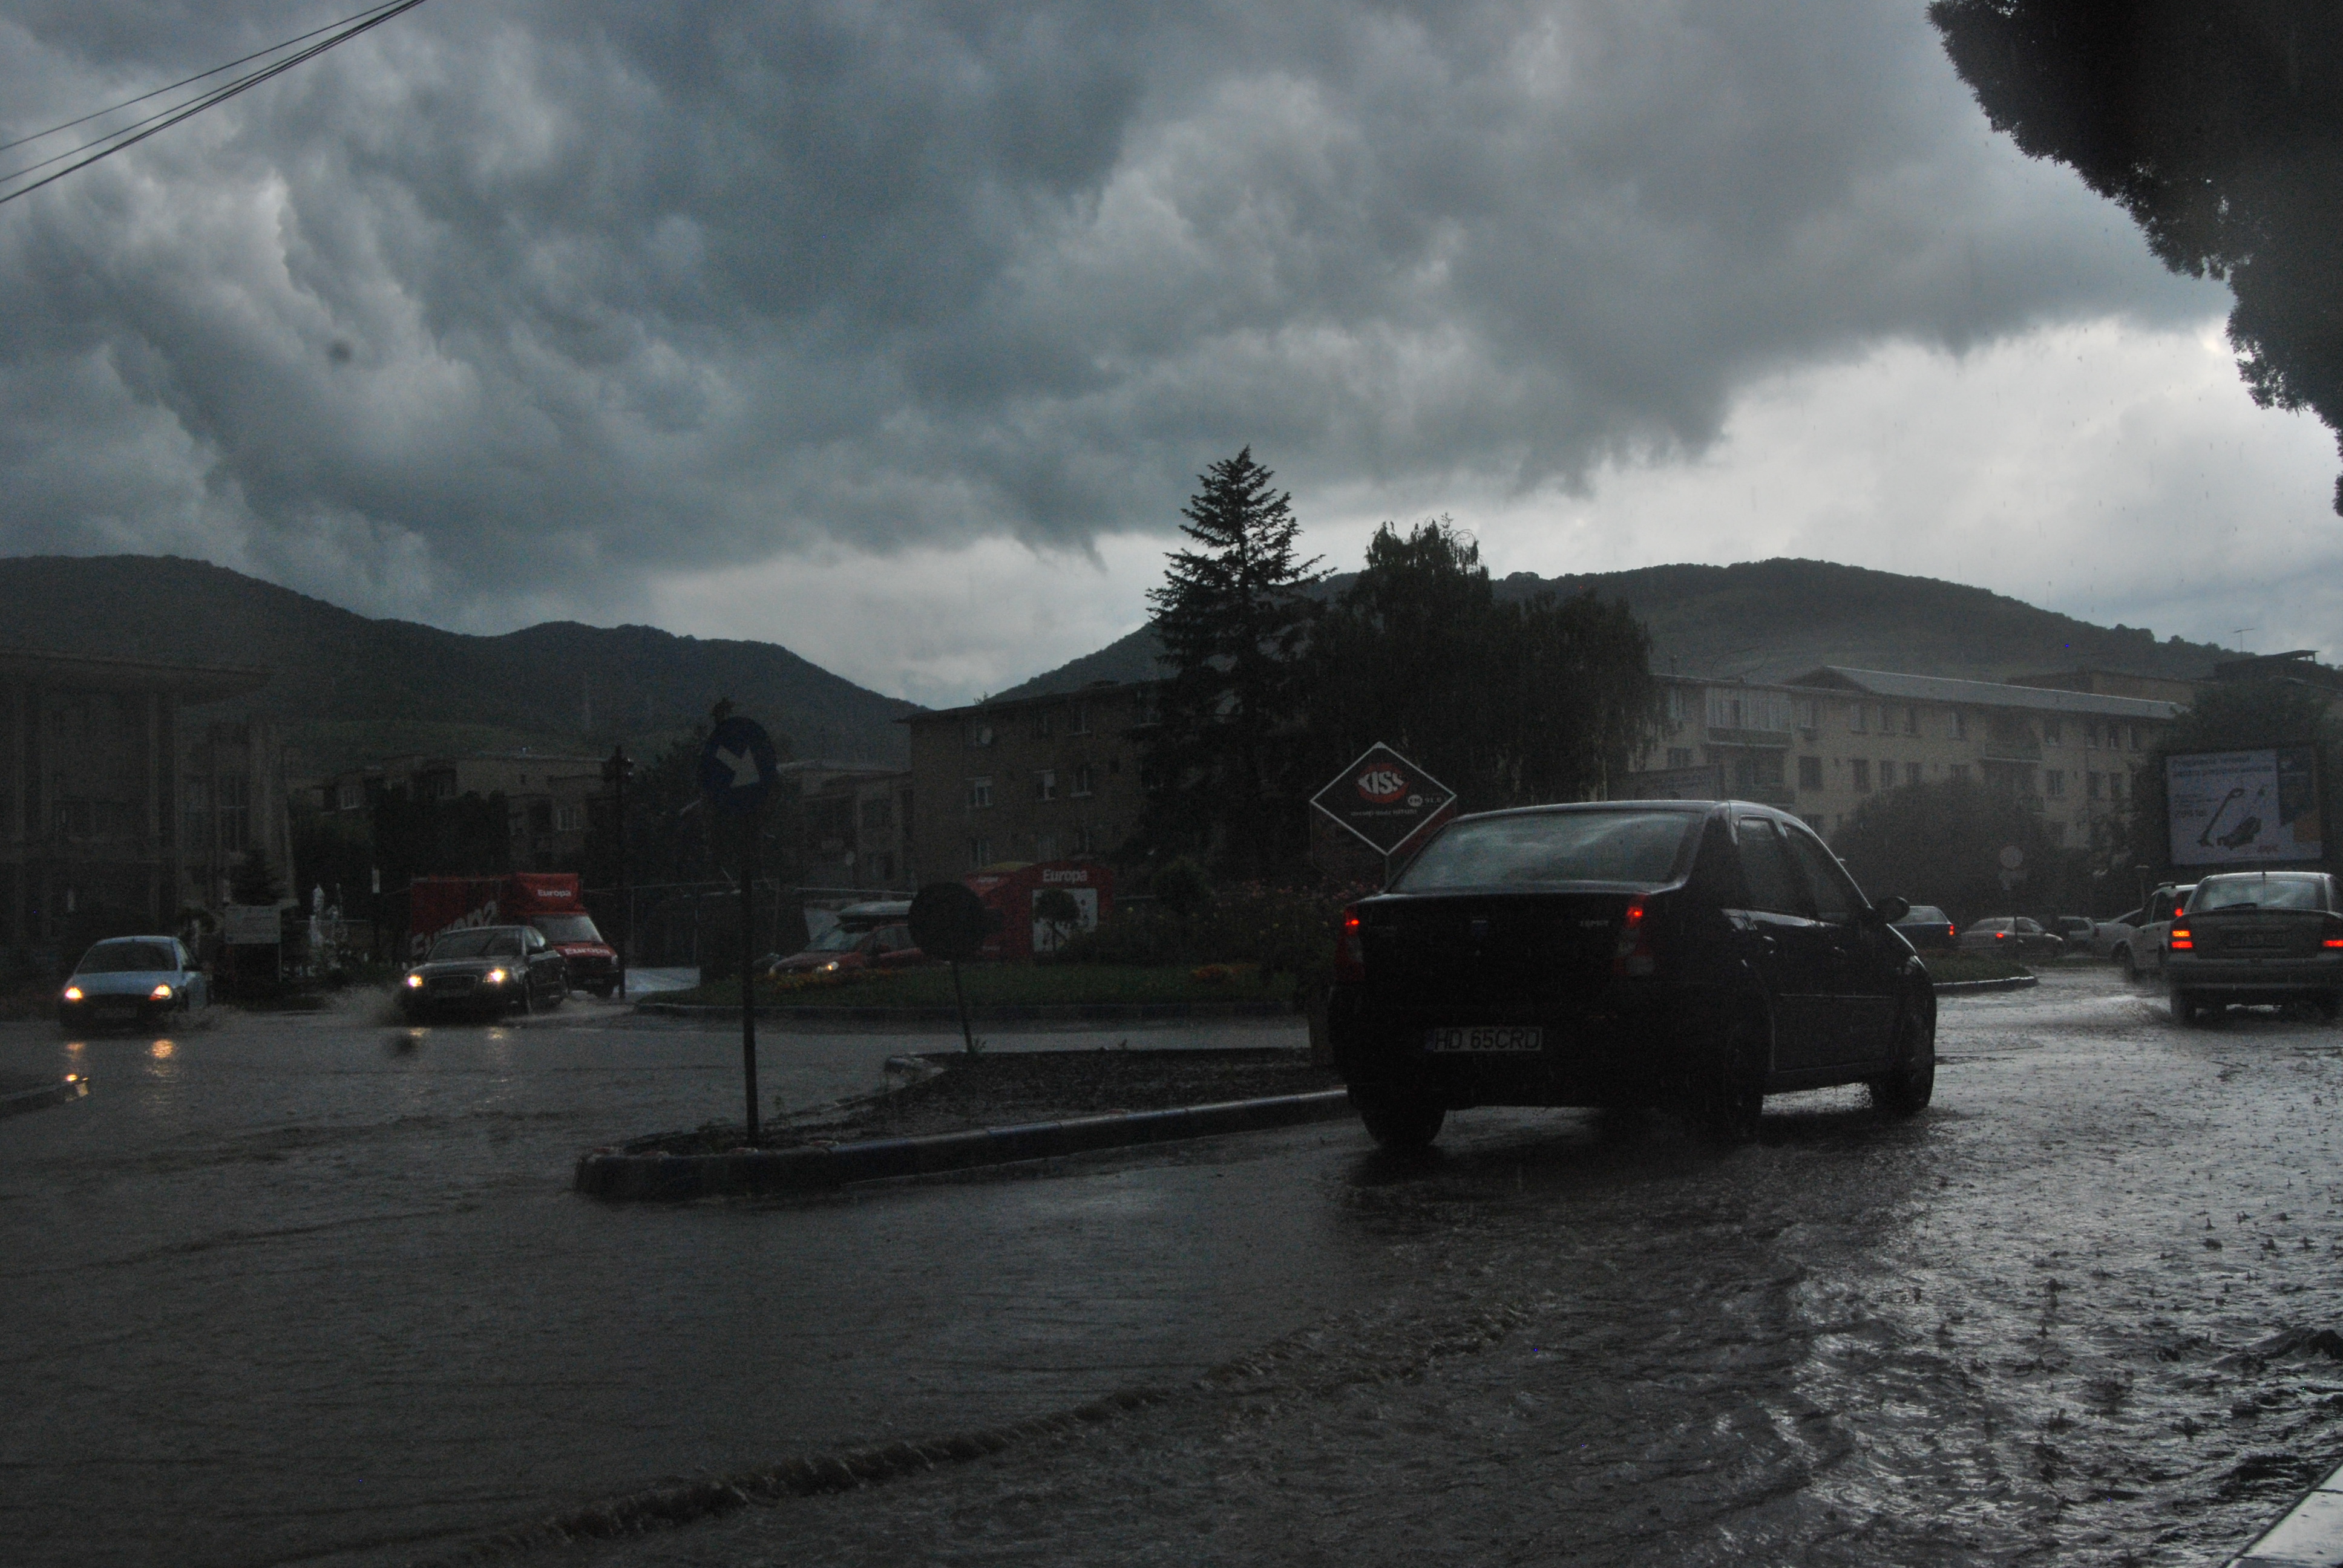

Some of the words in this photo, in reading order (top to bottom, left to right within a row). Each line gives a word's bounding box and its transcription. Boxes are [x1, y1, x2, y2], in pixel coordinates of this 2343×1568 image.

[1357, 771, 1404, 795] KISS
[1043, 869, 1088, 883] Europa
[537, 889, 572, 898] Europa
[1435, 1029, 1463, 1050] HD
[1470, 1029, 1540, 1049] 65CRD
